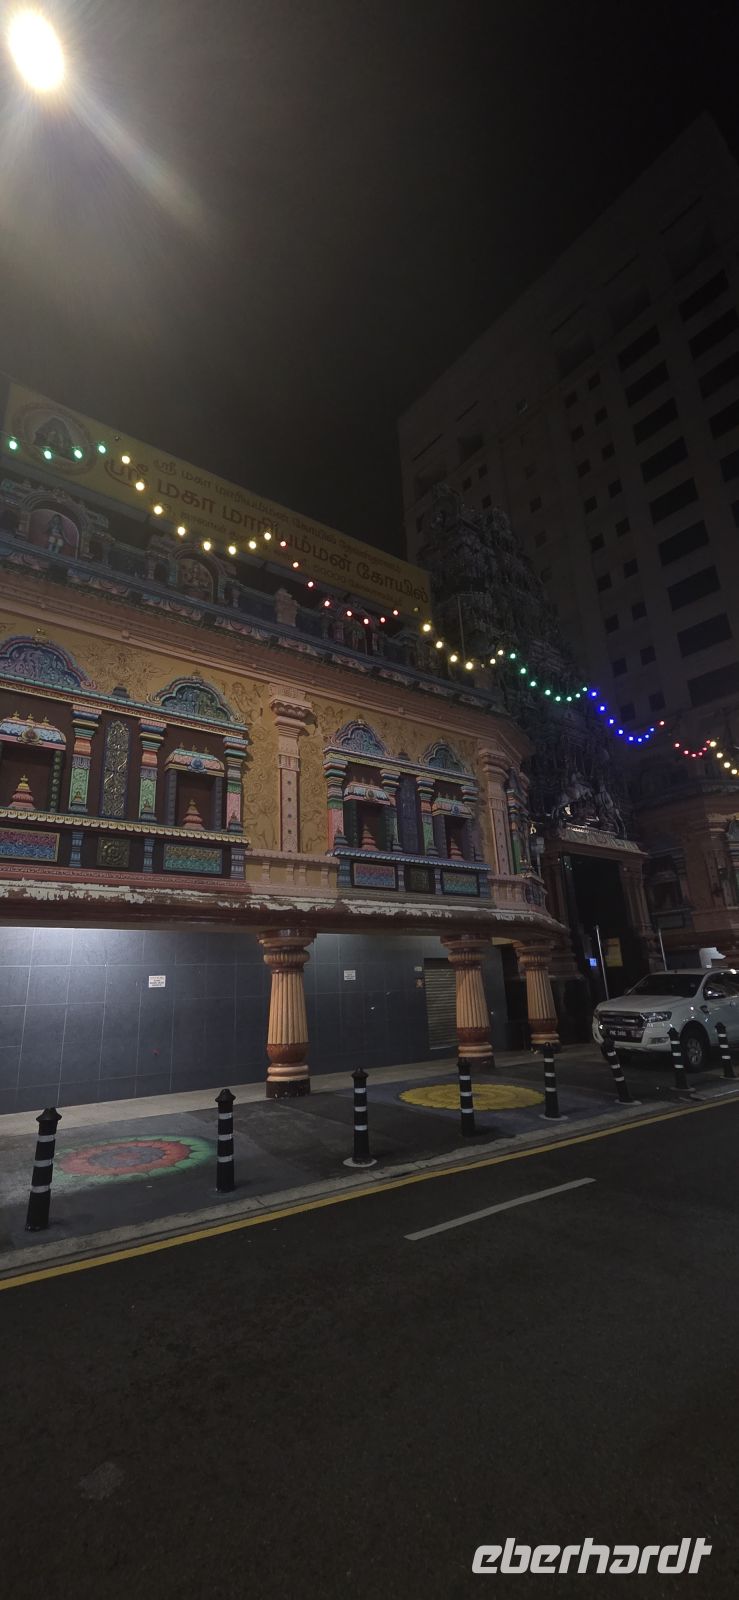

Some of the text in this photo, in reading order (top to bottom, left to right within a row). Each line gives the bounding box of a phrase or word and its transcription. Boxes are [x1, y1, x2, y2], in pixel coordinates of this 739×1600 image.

[158, 478, 216, 514] மகா
[222, 505, 352, 574] மாரியம்மன்
[356, 560, 429, 604] கோயில்
